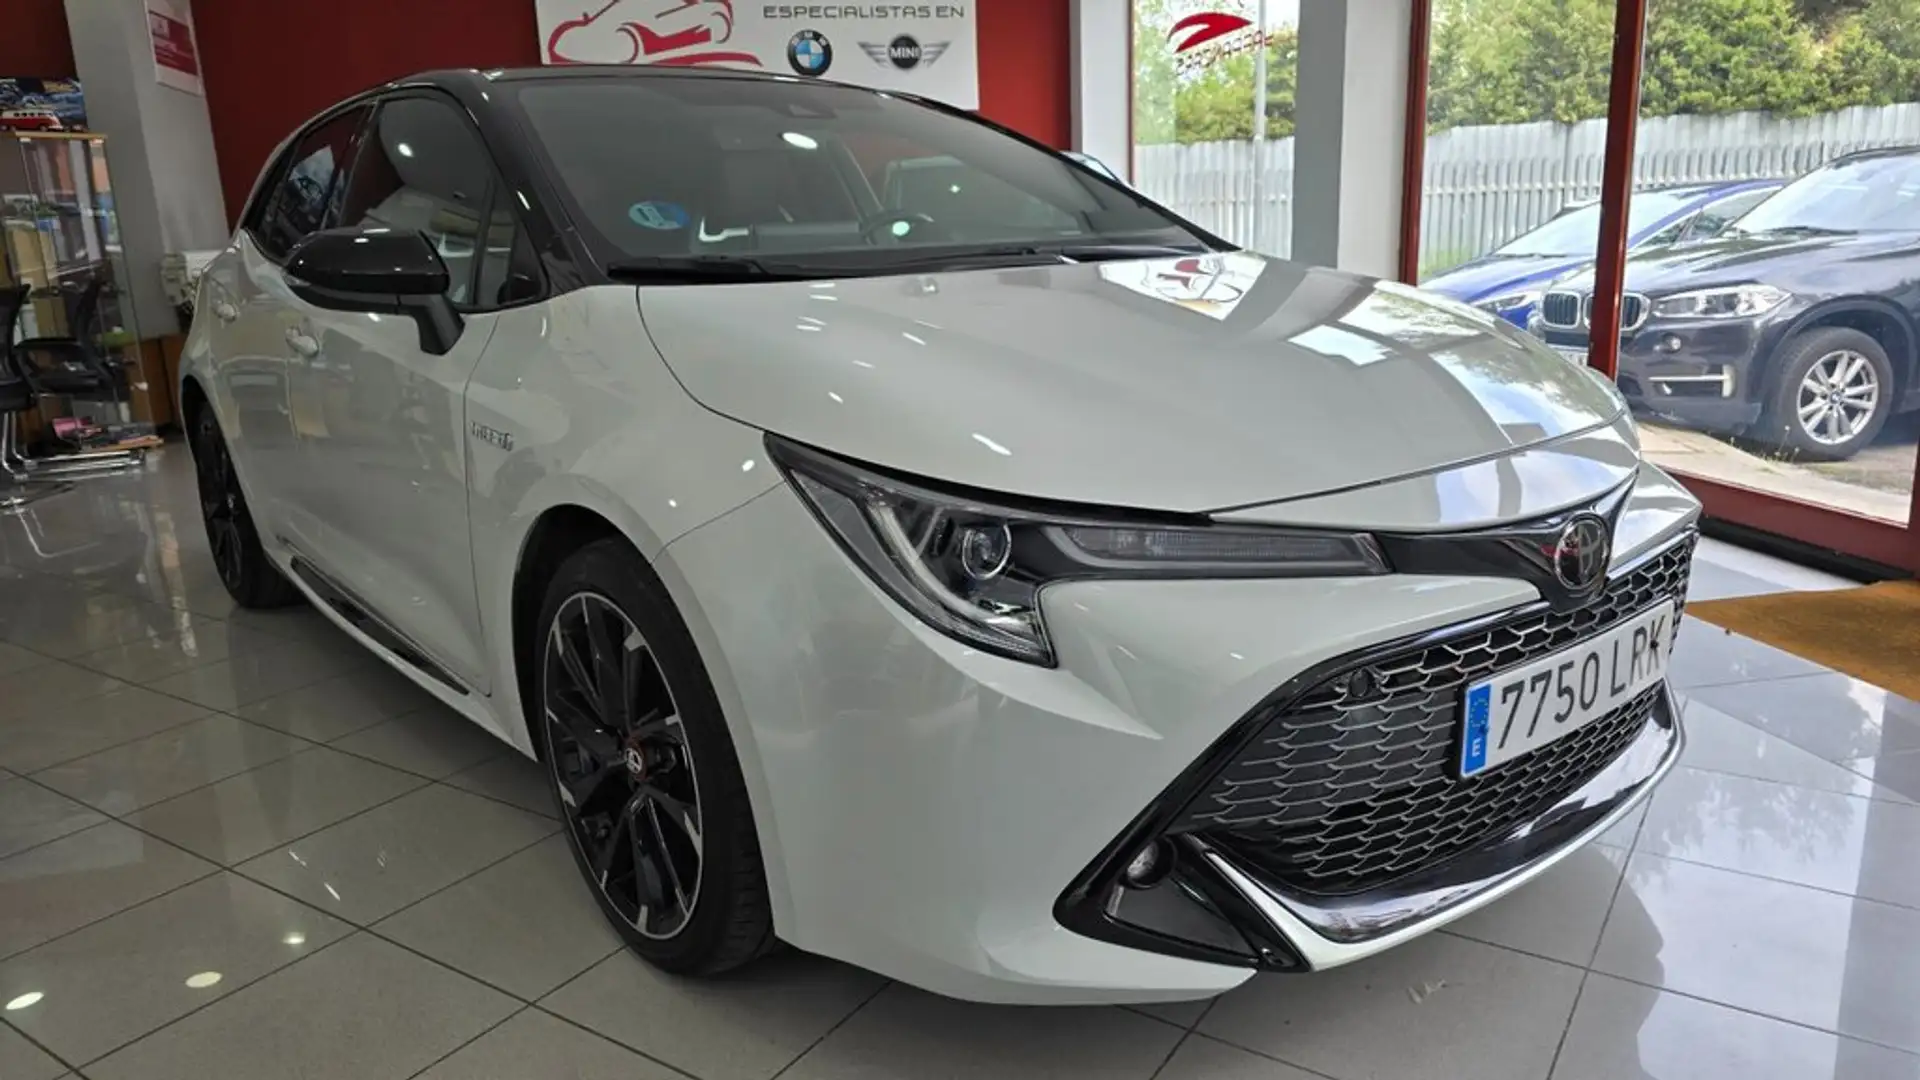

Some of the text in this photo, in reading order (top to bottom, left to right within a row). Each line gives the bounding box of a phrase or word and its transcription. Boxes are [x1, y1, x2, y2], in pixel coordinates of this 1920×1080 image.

[763, 5, 965, 19] ESPECIALISTAS EN
[890, 47, 920, 59] MINI
[1471, 615, 1667, 757] E 7750 LRK
